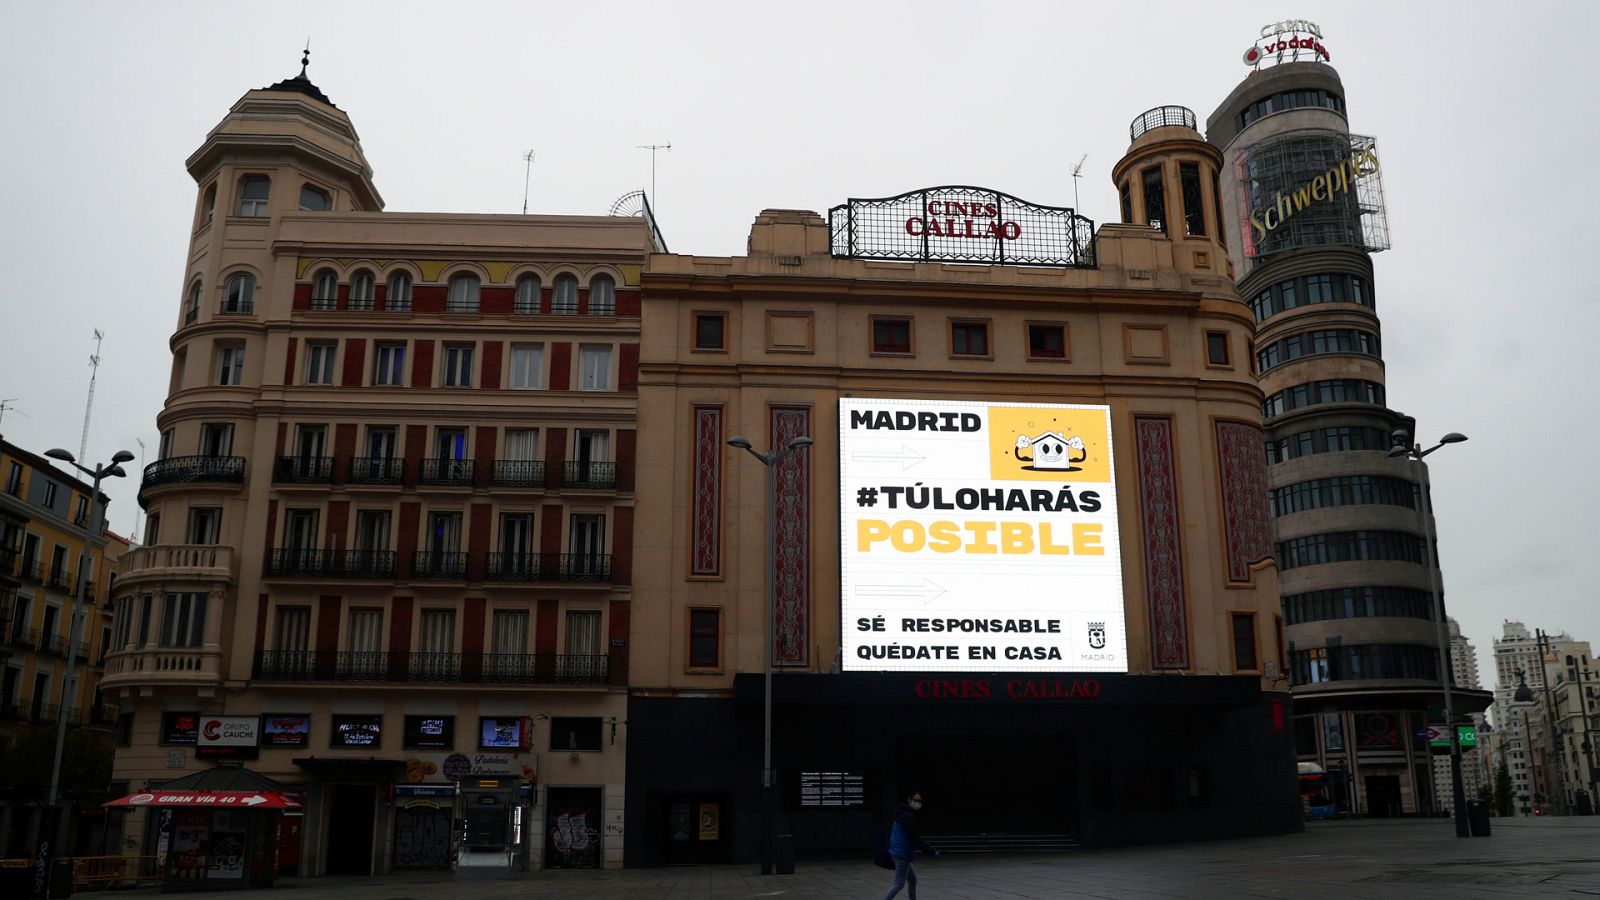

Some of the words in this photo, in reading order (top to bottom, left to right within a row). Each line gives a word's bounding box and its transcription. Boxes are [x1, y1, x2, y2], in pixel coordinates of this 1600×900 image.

[1250, 144, 1380, 245] Schweppes
[928, 200, 997, 218] CINES
[905, 217, 1021, 241] CALLAO
[850, 410, 982, 432] MADRID
[856, 482, 1102, 513] #TÚLOHARÁS
[857, 519, 1105, 556] POSIBLE
[857, 615, 886, 632] SÉ
[901, 617, 1061, 634] RESPONSABLE
[857, 642, 960, 660] QUÉDATE
[968, 646, 996, 660] EN
[1004, 646, 1063, 661] CASA
[1081, 653, 1115, 661] MADRID
[914, 679, 992, 699] CINES
[1007, 679, 1102, 699] CALLAO
[158, 795, 193, 803] GRAN
